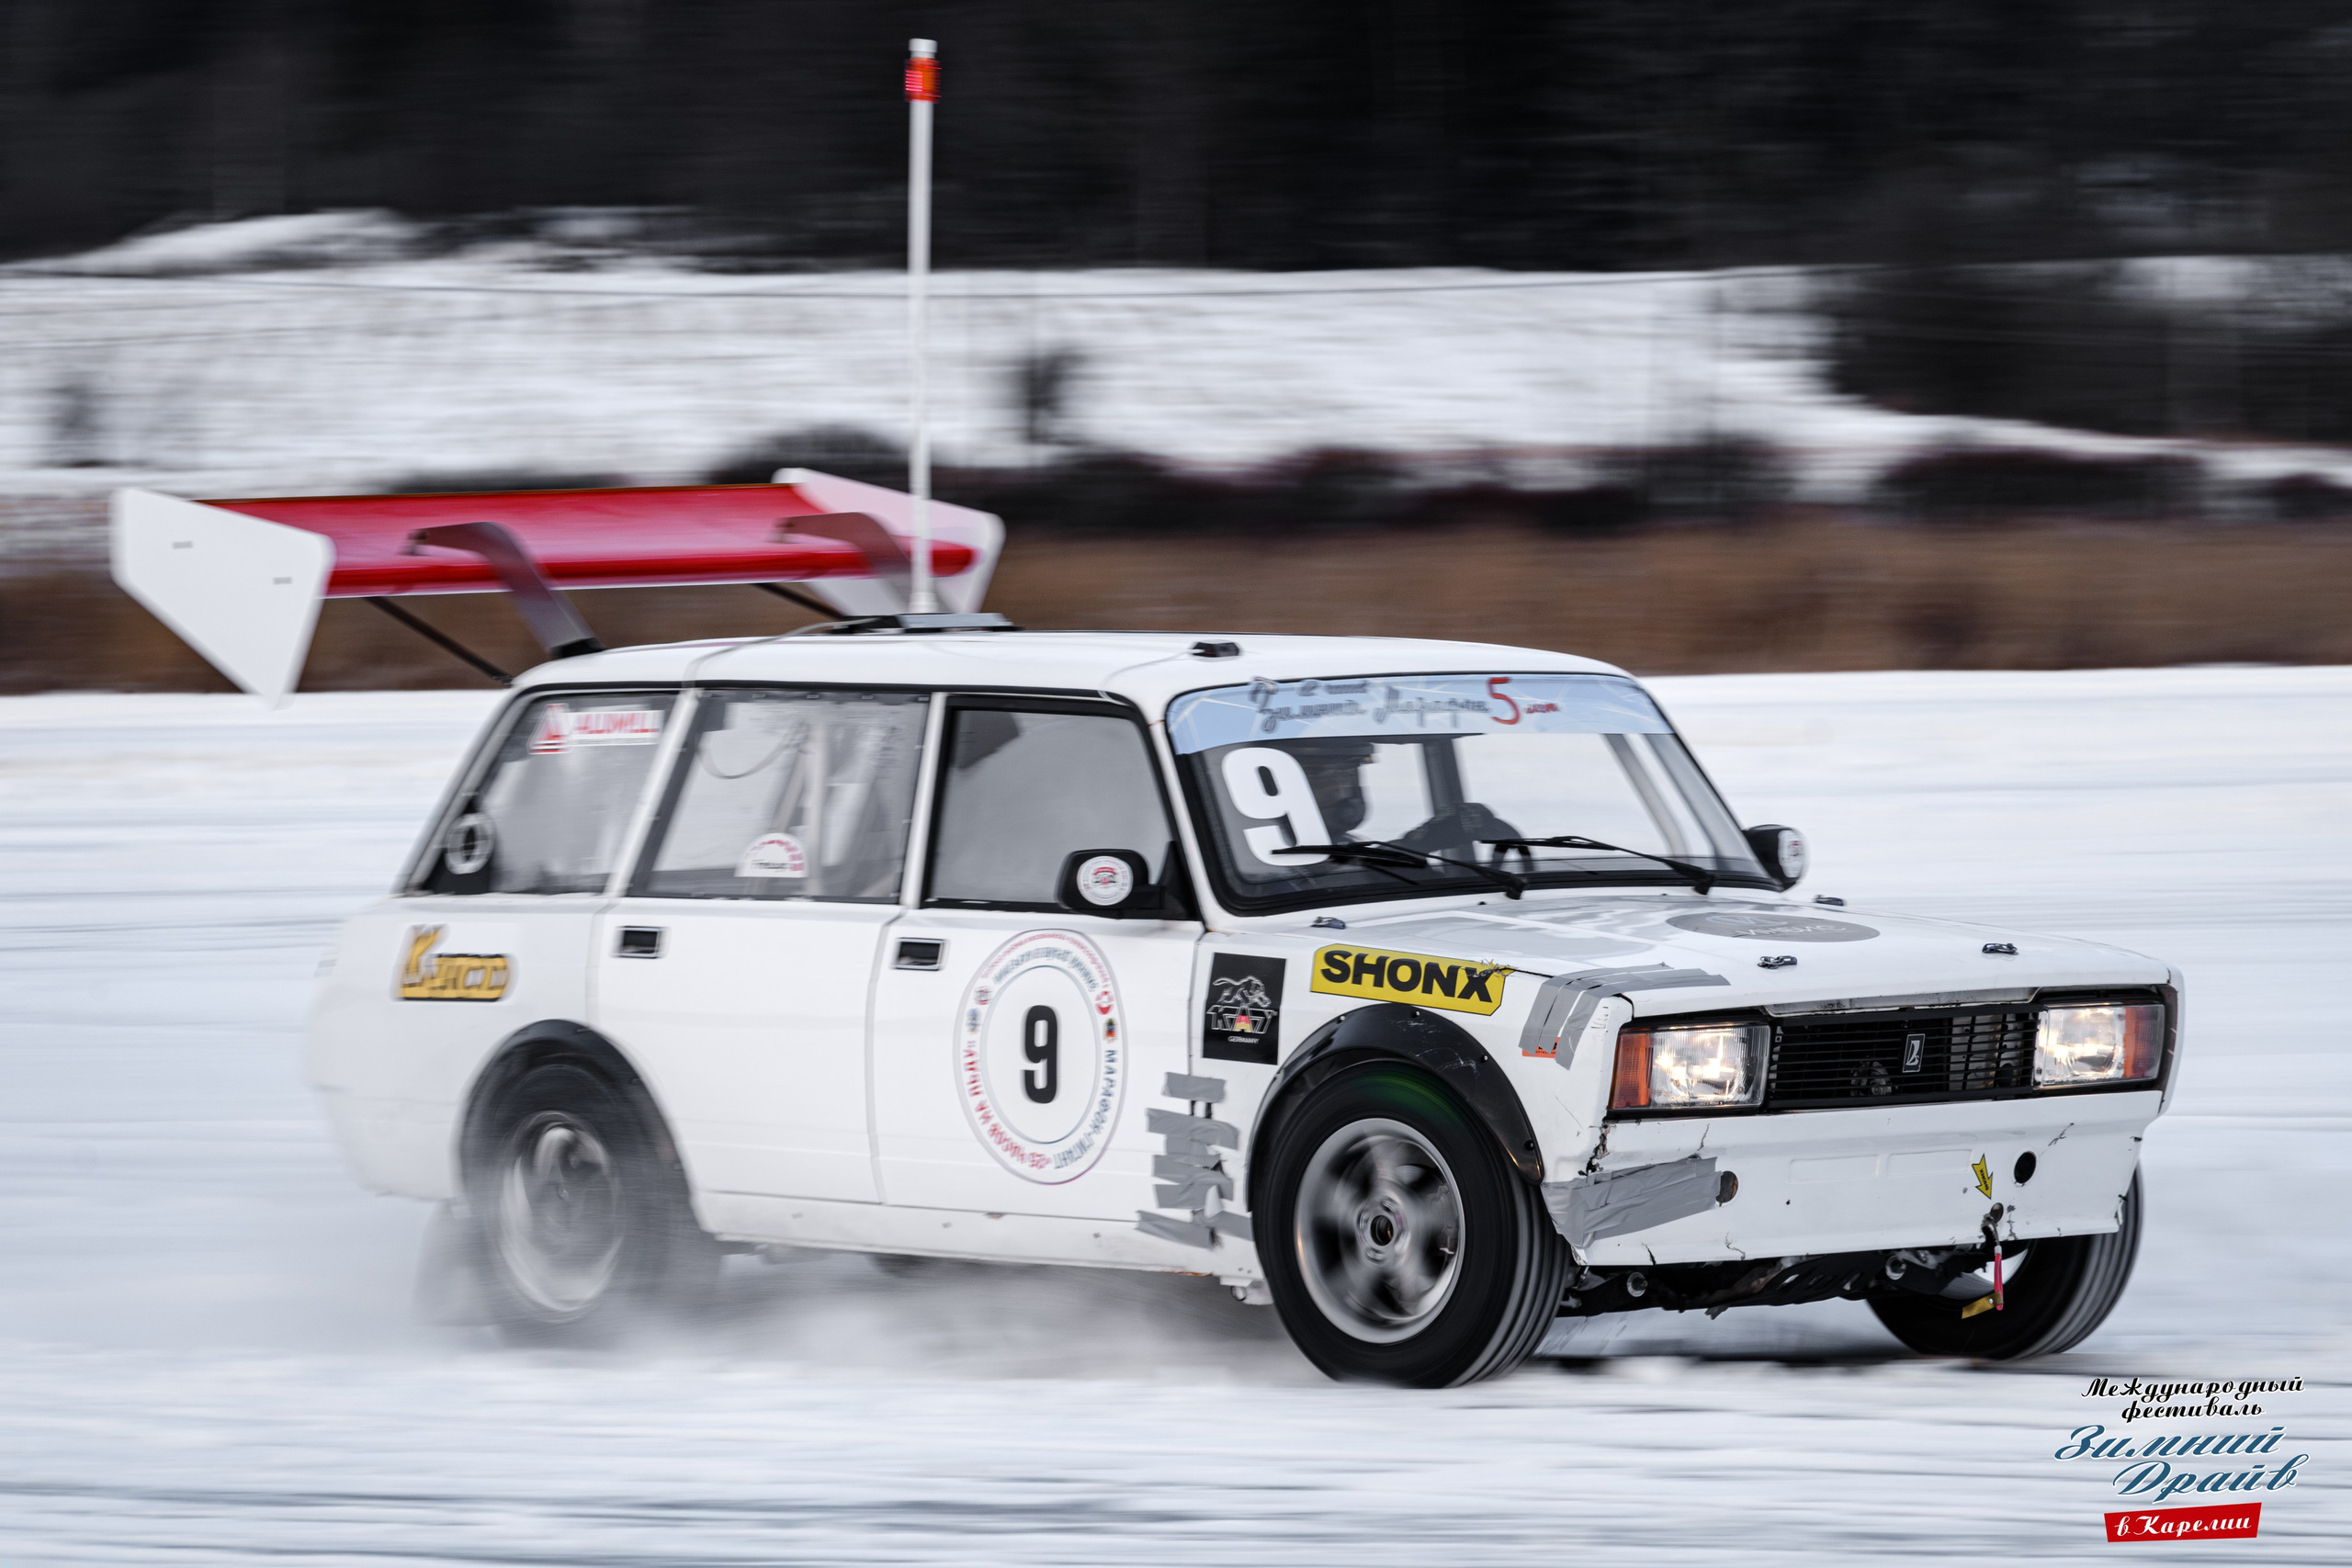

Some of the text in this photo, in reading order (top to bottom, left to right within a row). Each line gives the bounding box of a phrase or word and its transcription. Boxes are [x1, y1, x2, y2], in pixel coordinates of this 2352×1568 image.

[1222, 747, 1330, 866] 9
[1321, 950, 1493, 1003] SHONX
[1022, 1005, 1058, 1104] 9
